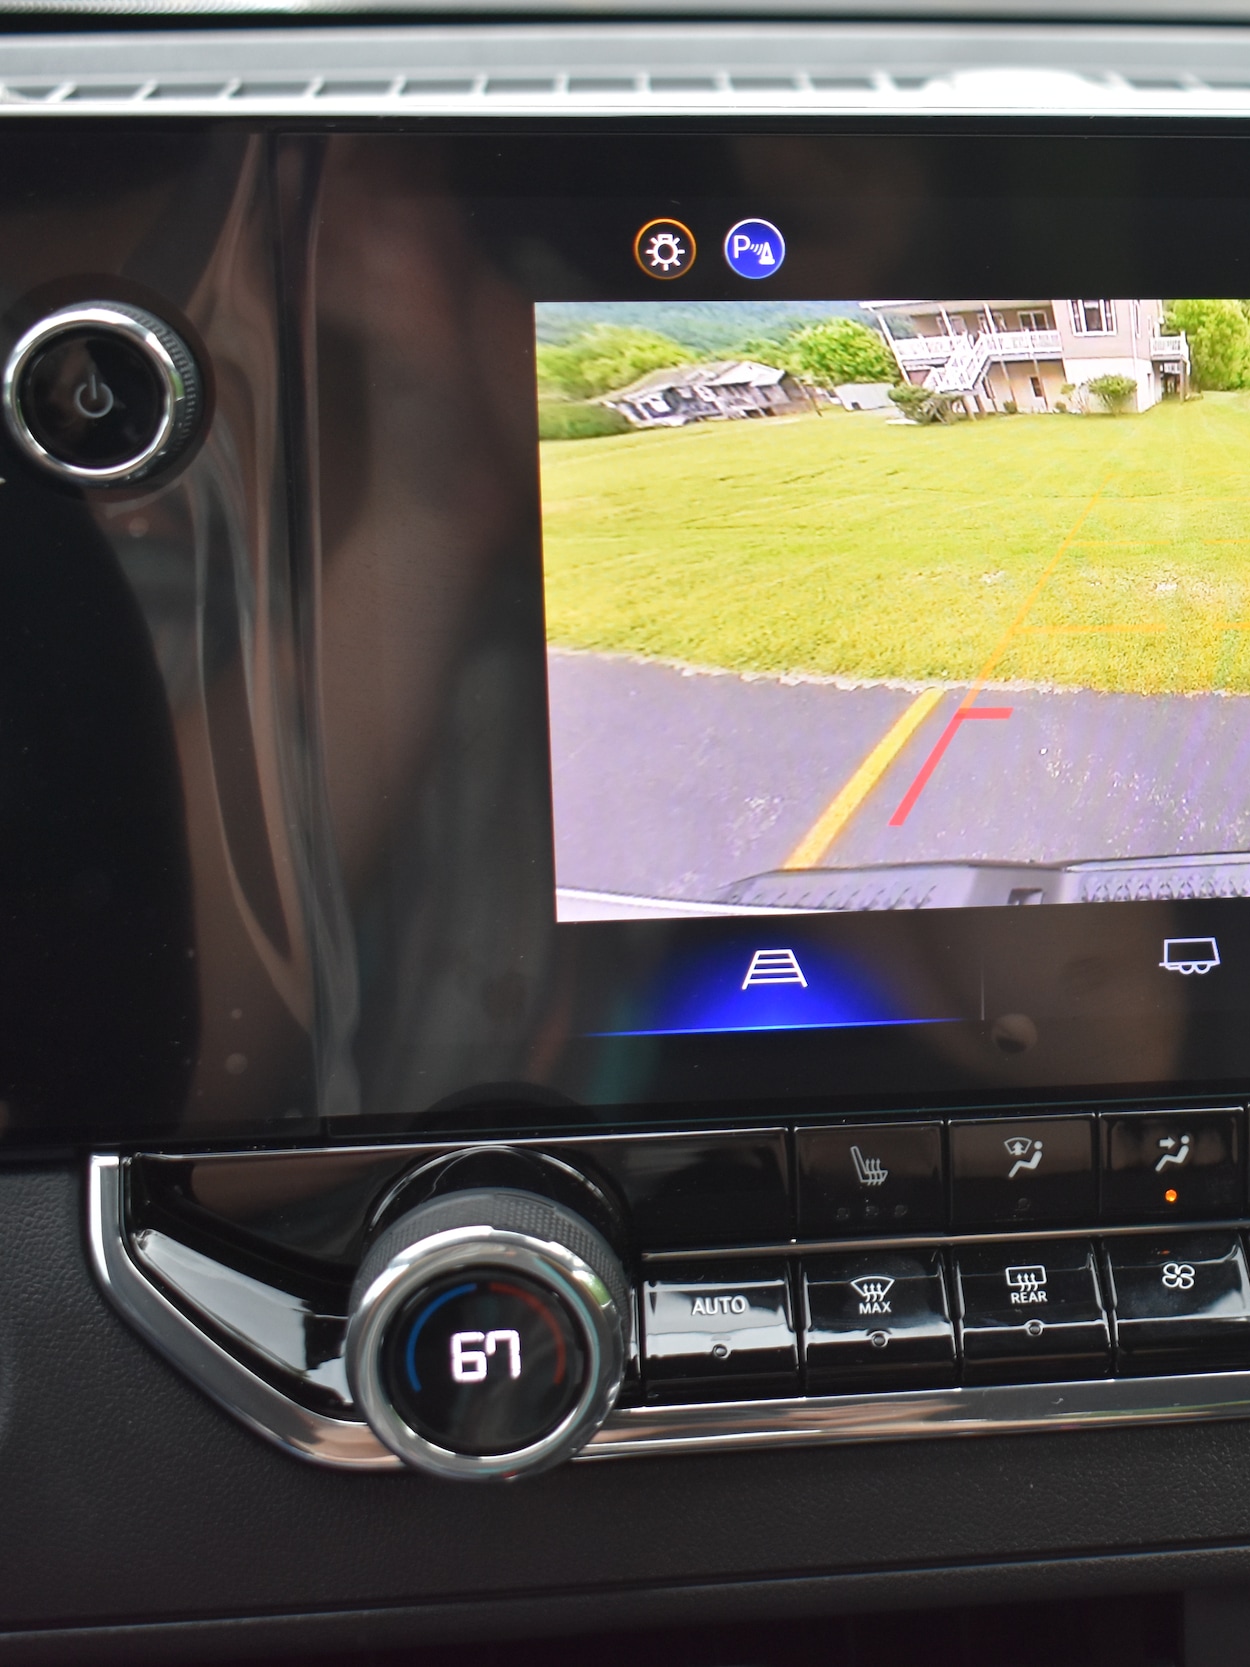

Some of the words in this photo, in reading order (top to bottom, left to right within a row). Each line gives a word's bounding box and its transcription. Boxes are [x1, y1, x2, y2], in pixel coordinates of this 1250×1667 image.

[1010, 1291, 1048, 1304] REAR
[692, 1296, 746, 1316] AUTO
[859, 1301, 892, 1314] MAX
[450, 1329, 521, 1382] 67
